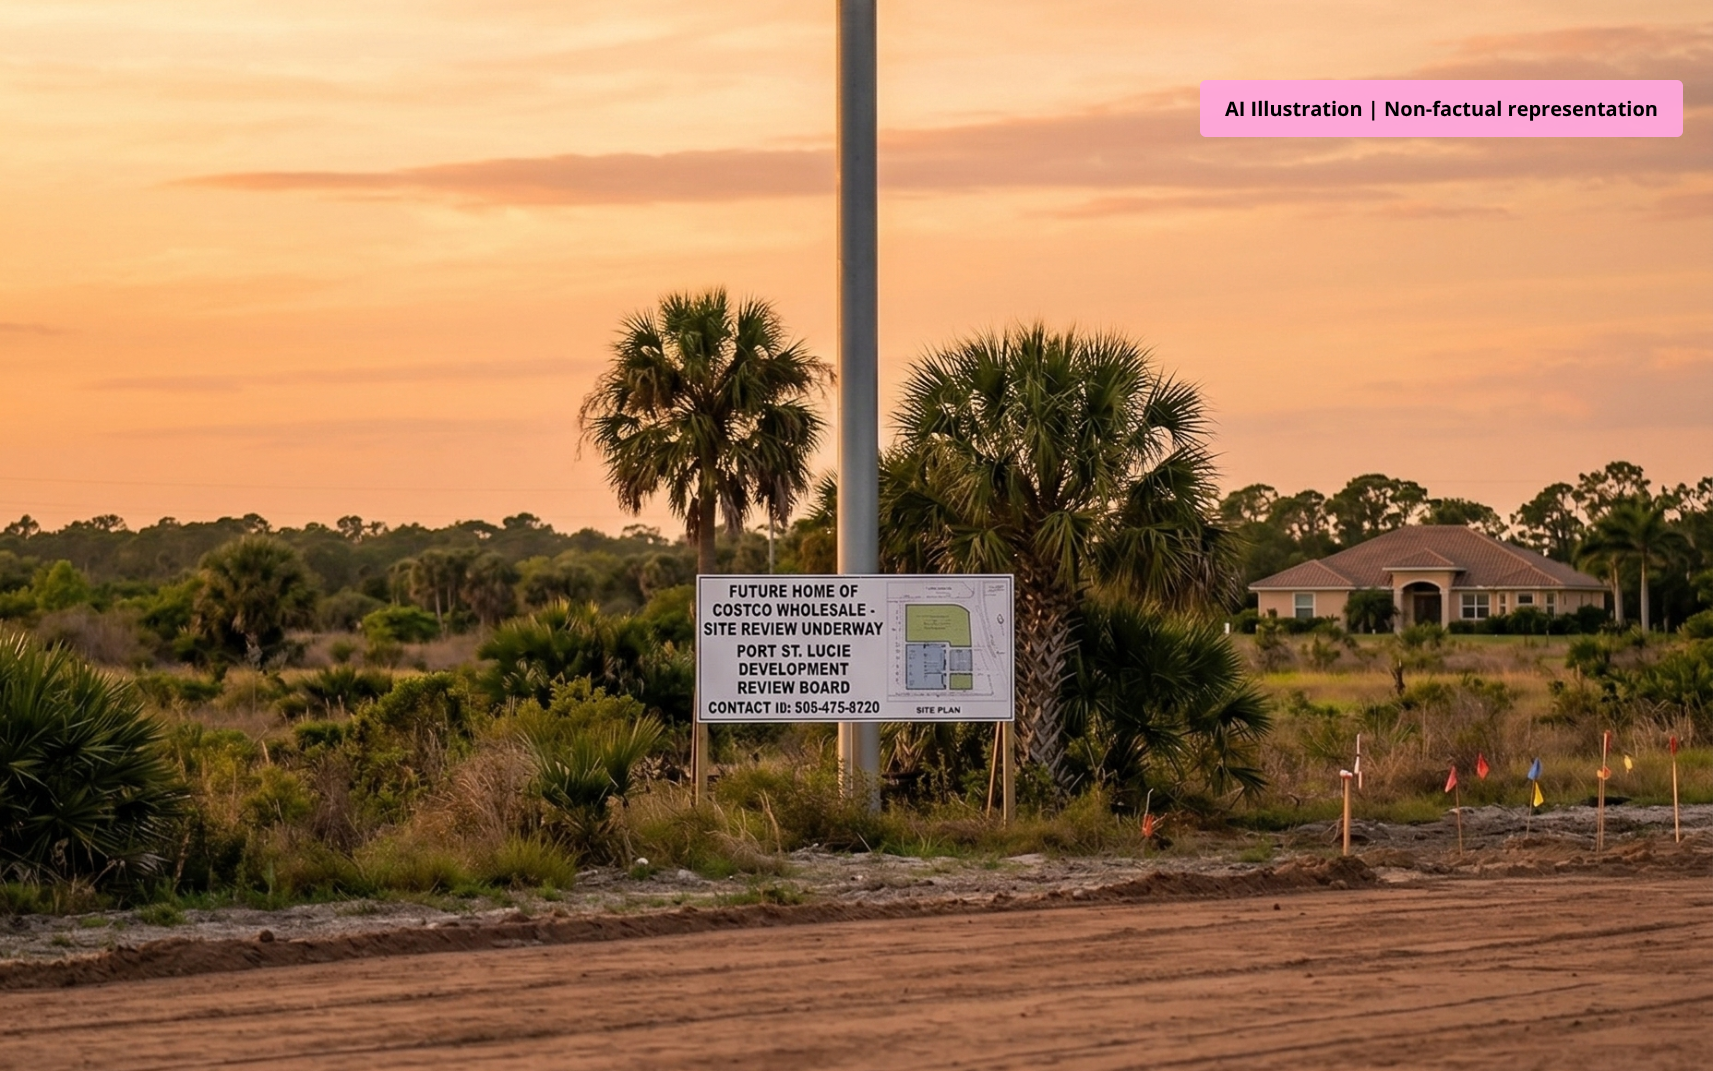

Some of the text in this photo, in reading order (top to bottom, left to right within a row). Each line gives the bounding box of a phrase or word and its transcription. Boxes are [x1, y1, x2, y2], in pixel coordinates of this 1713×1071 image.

[729, 584, 859, 598] FUTURE HOME OF
[712, 603, 773, 617] COSTCO
[777, 603, 867, 617] WHOLESALE
[703, 622, 884, 636] SITE REVIEW UNDERWAY
[736, 644, 851, 658] PORT ST. LUCIE
[738, 662, 850, 676] DEVELOPMENT
[737, 681, 851, 694] REVIEW BOARD
[708, 701, 772, 714] CONTACT
[775, 701, 792, 714] ID:
[916, 706, 961, 714] SITE PLAN
